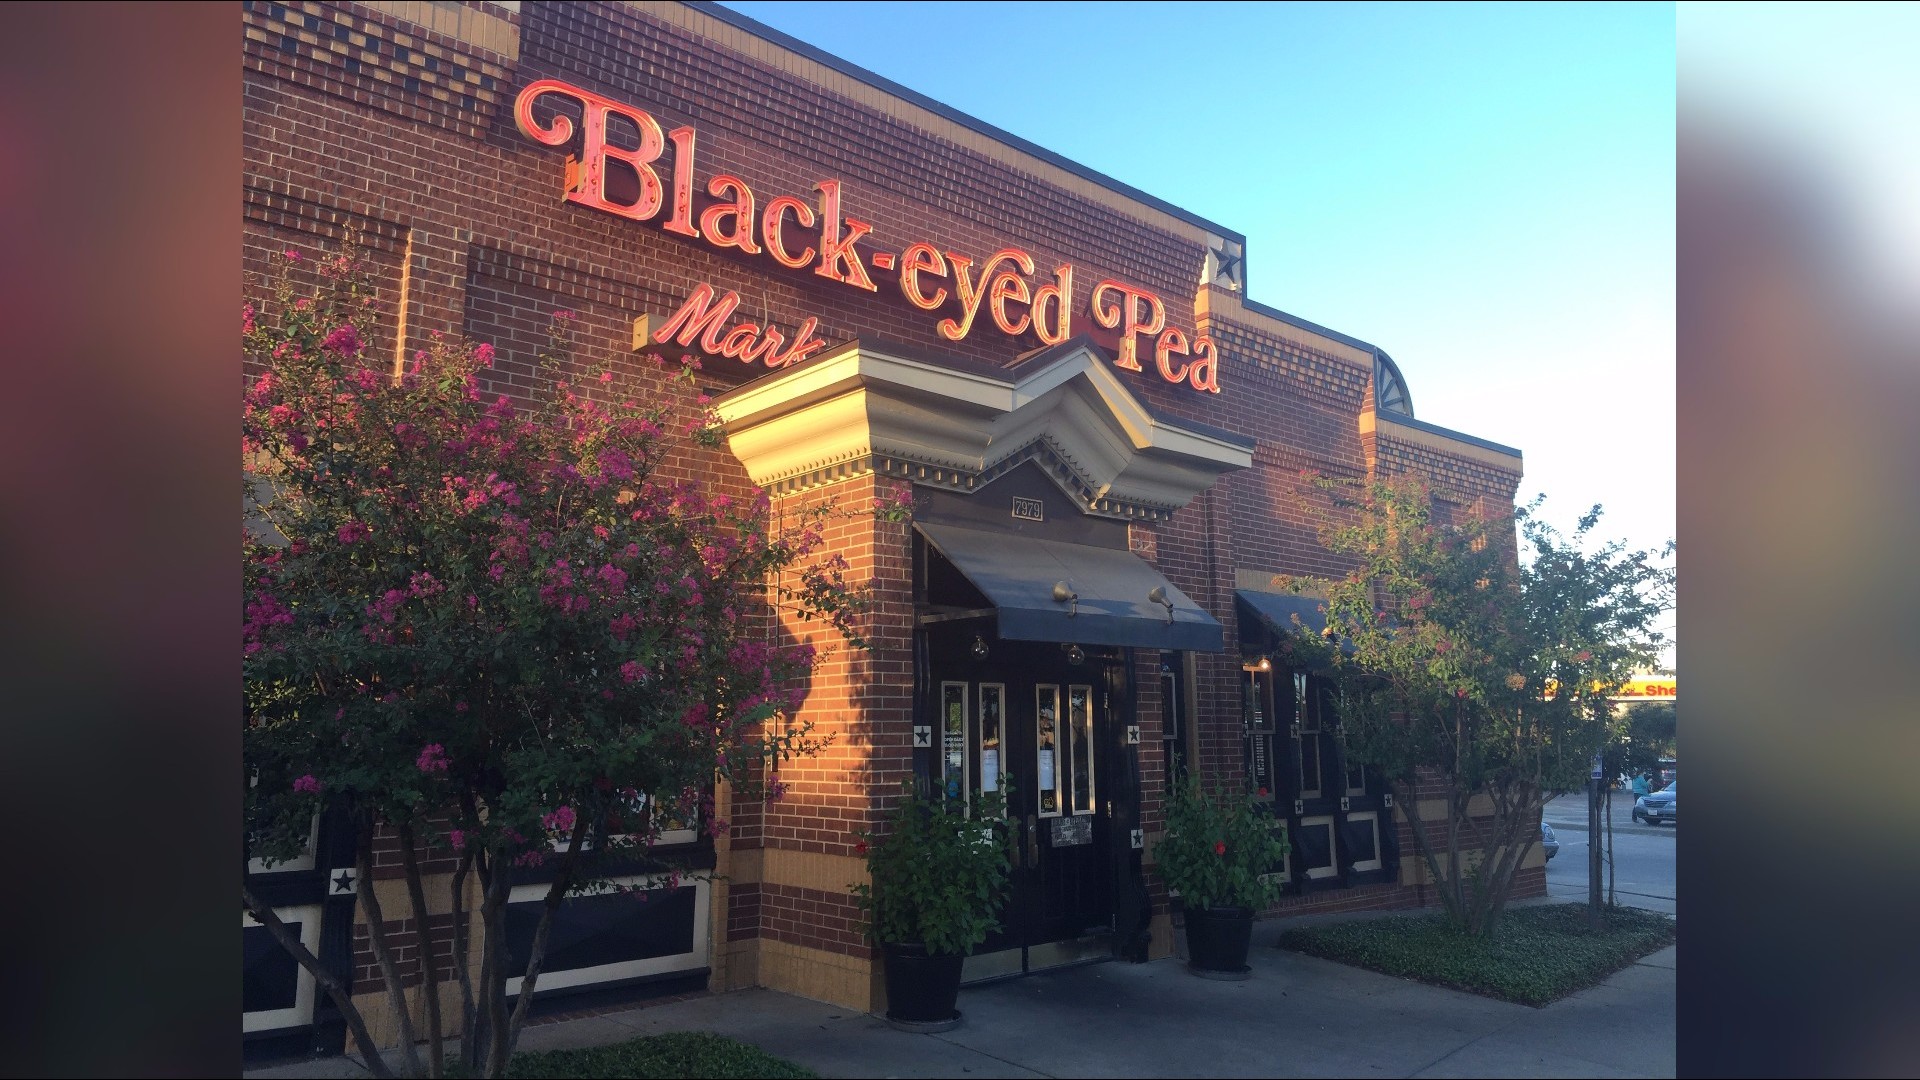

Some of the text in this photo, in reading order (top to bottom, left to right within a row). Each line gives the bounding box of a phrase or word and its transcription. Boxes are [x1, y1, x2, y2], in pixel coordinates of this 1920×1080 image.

[514, 78, 1221, 394] Black-eyed Pea
[1015, 500, 1040, 518] 7979
